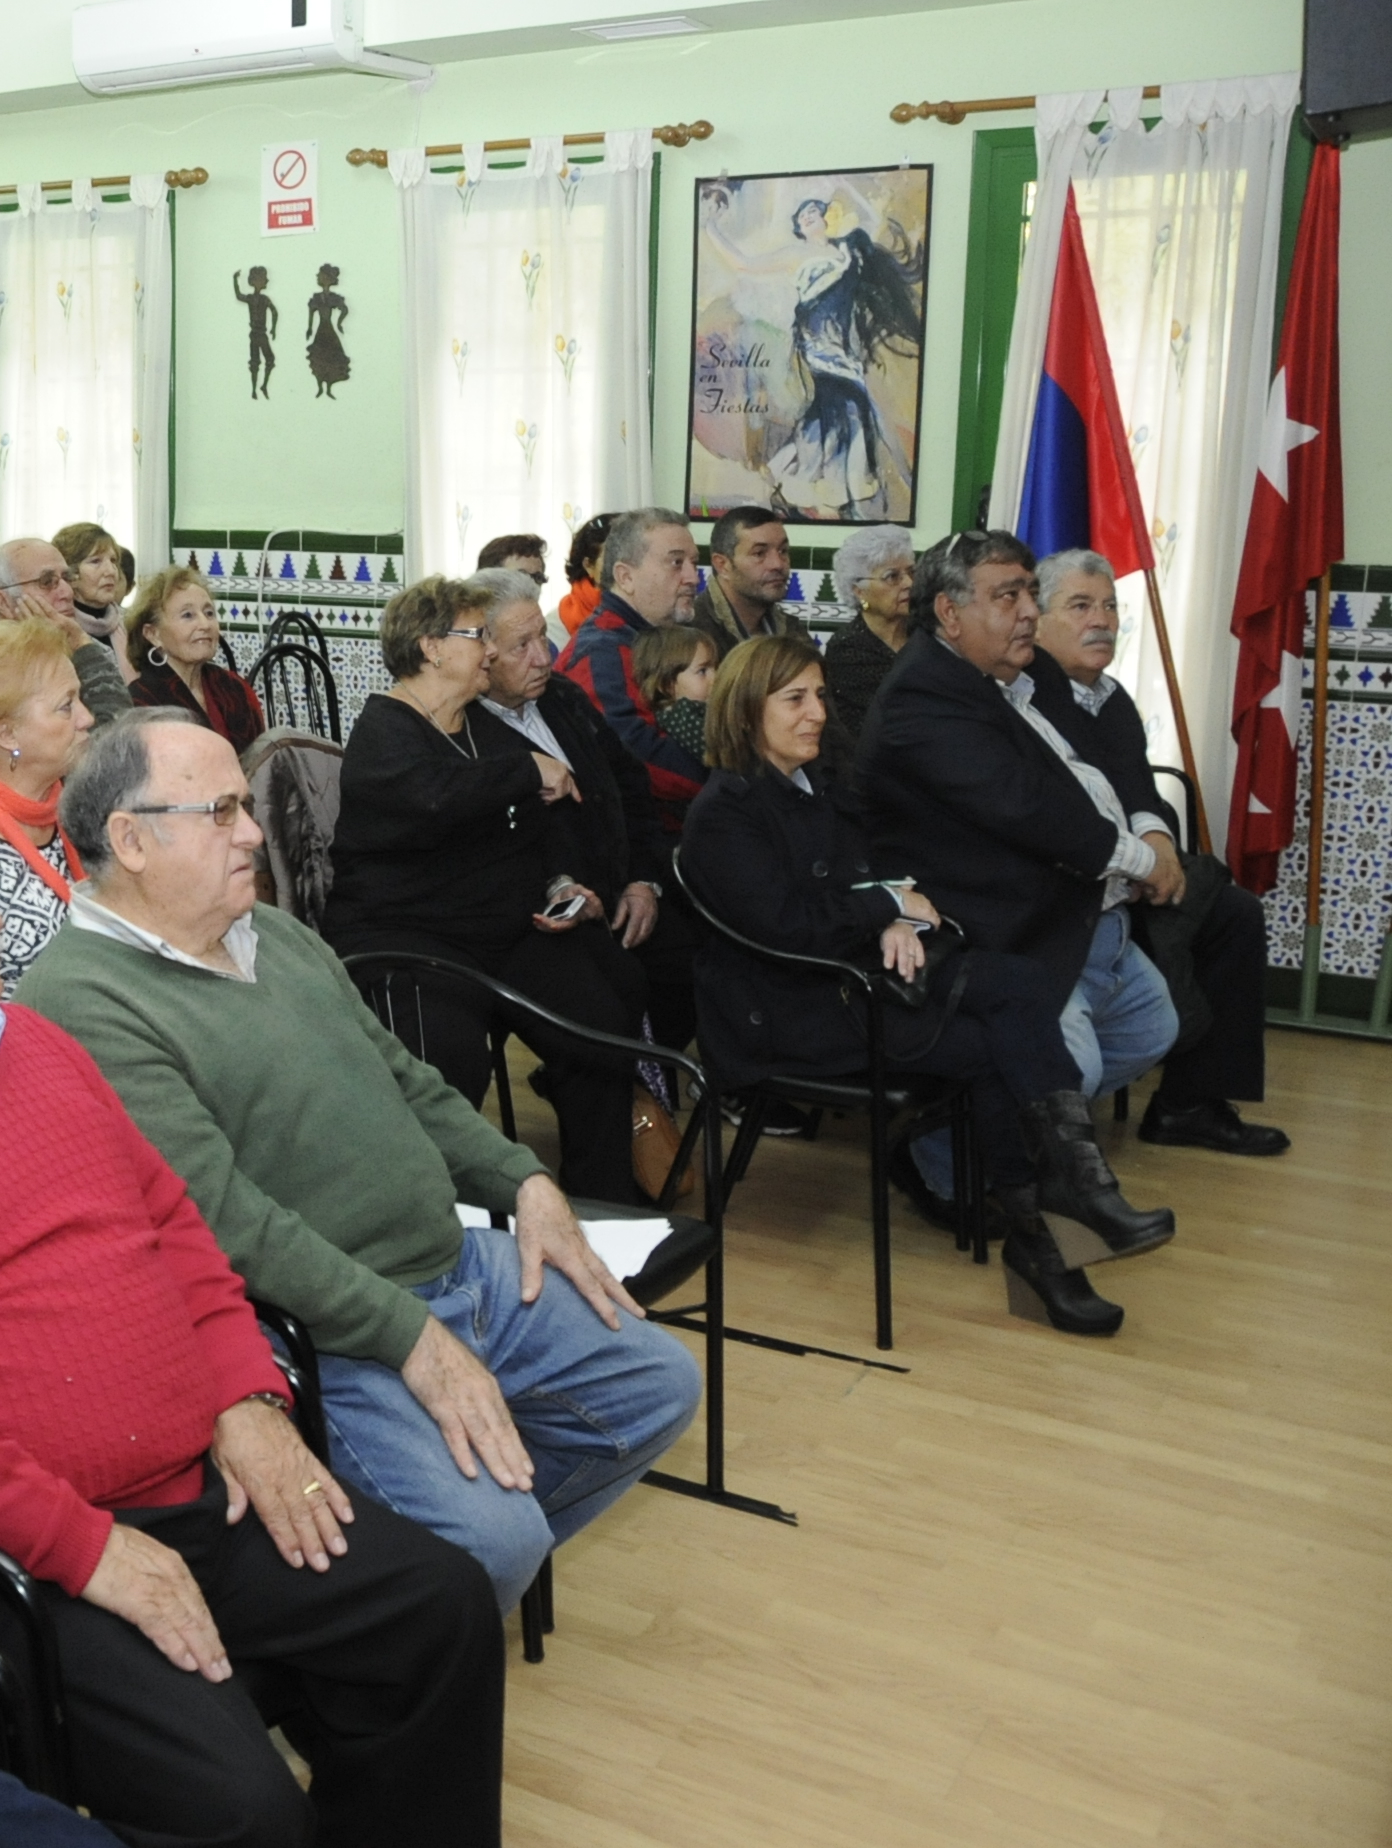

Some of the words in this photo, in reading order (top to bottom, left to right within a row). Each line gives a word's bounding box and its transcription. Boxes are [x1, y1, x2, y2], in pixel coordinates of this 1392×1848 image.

[271, 201, 310, 214] PROHIBIDO
[278, 213, 303, 225] FUMAR
[700, 342, 770, 368] Sevilla
[699, 374, 717, 383] en
[699, 387, 769, 414] Fiestas
